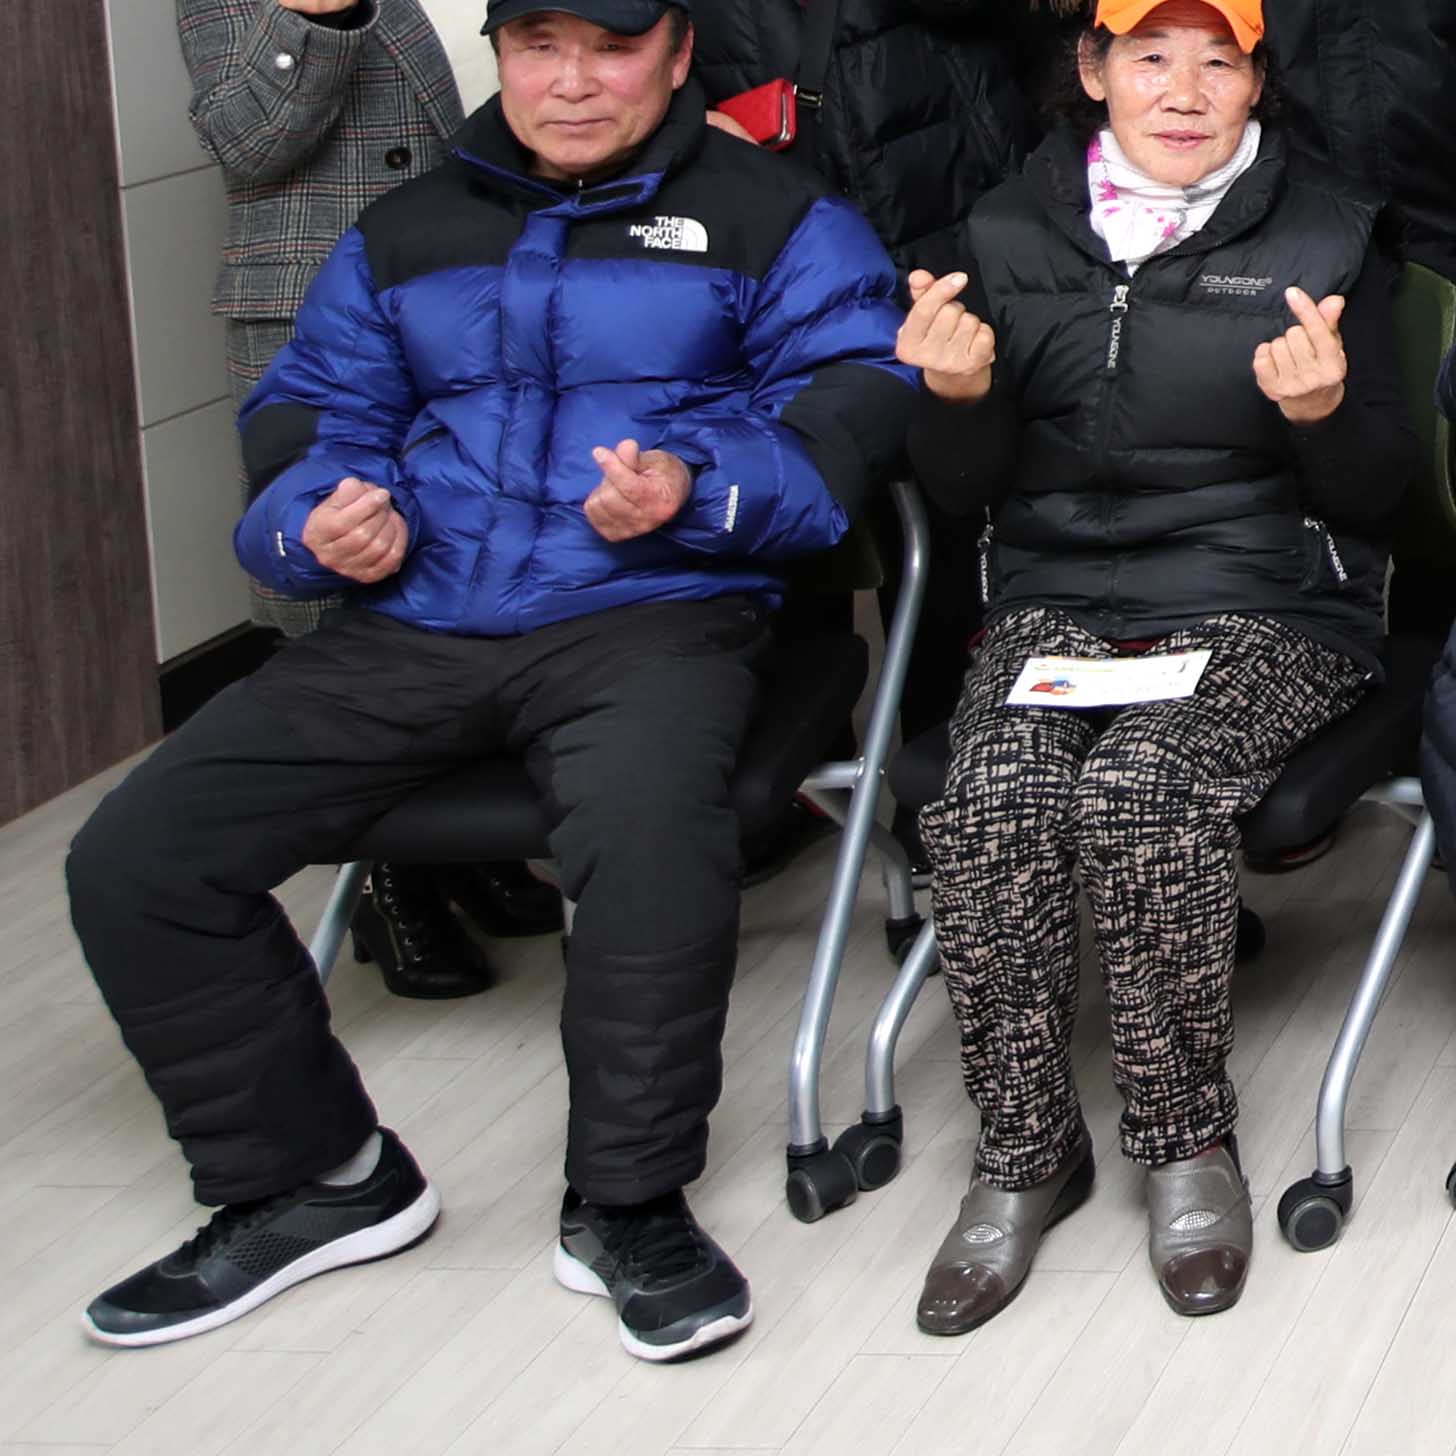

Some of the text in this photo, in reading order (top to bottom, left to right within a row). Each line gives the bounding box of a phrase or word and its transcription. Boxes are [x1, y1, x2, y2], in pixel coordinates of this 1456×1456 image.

[655, 216, 684, 228] THE
[630, 225, 682, 239] NORTH
[644, 237, 681, 250] FACE
[1207, 287, 1257, 297] OUTDOOR
